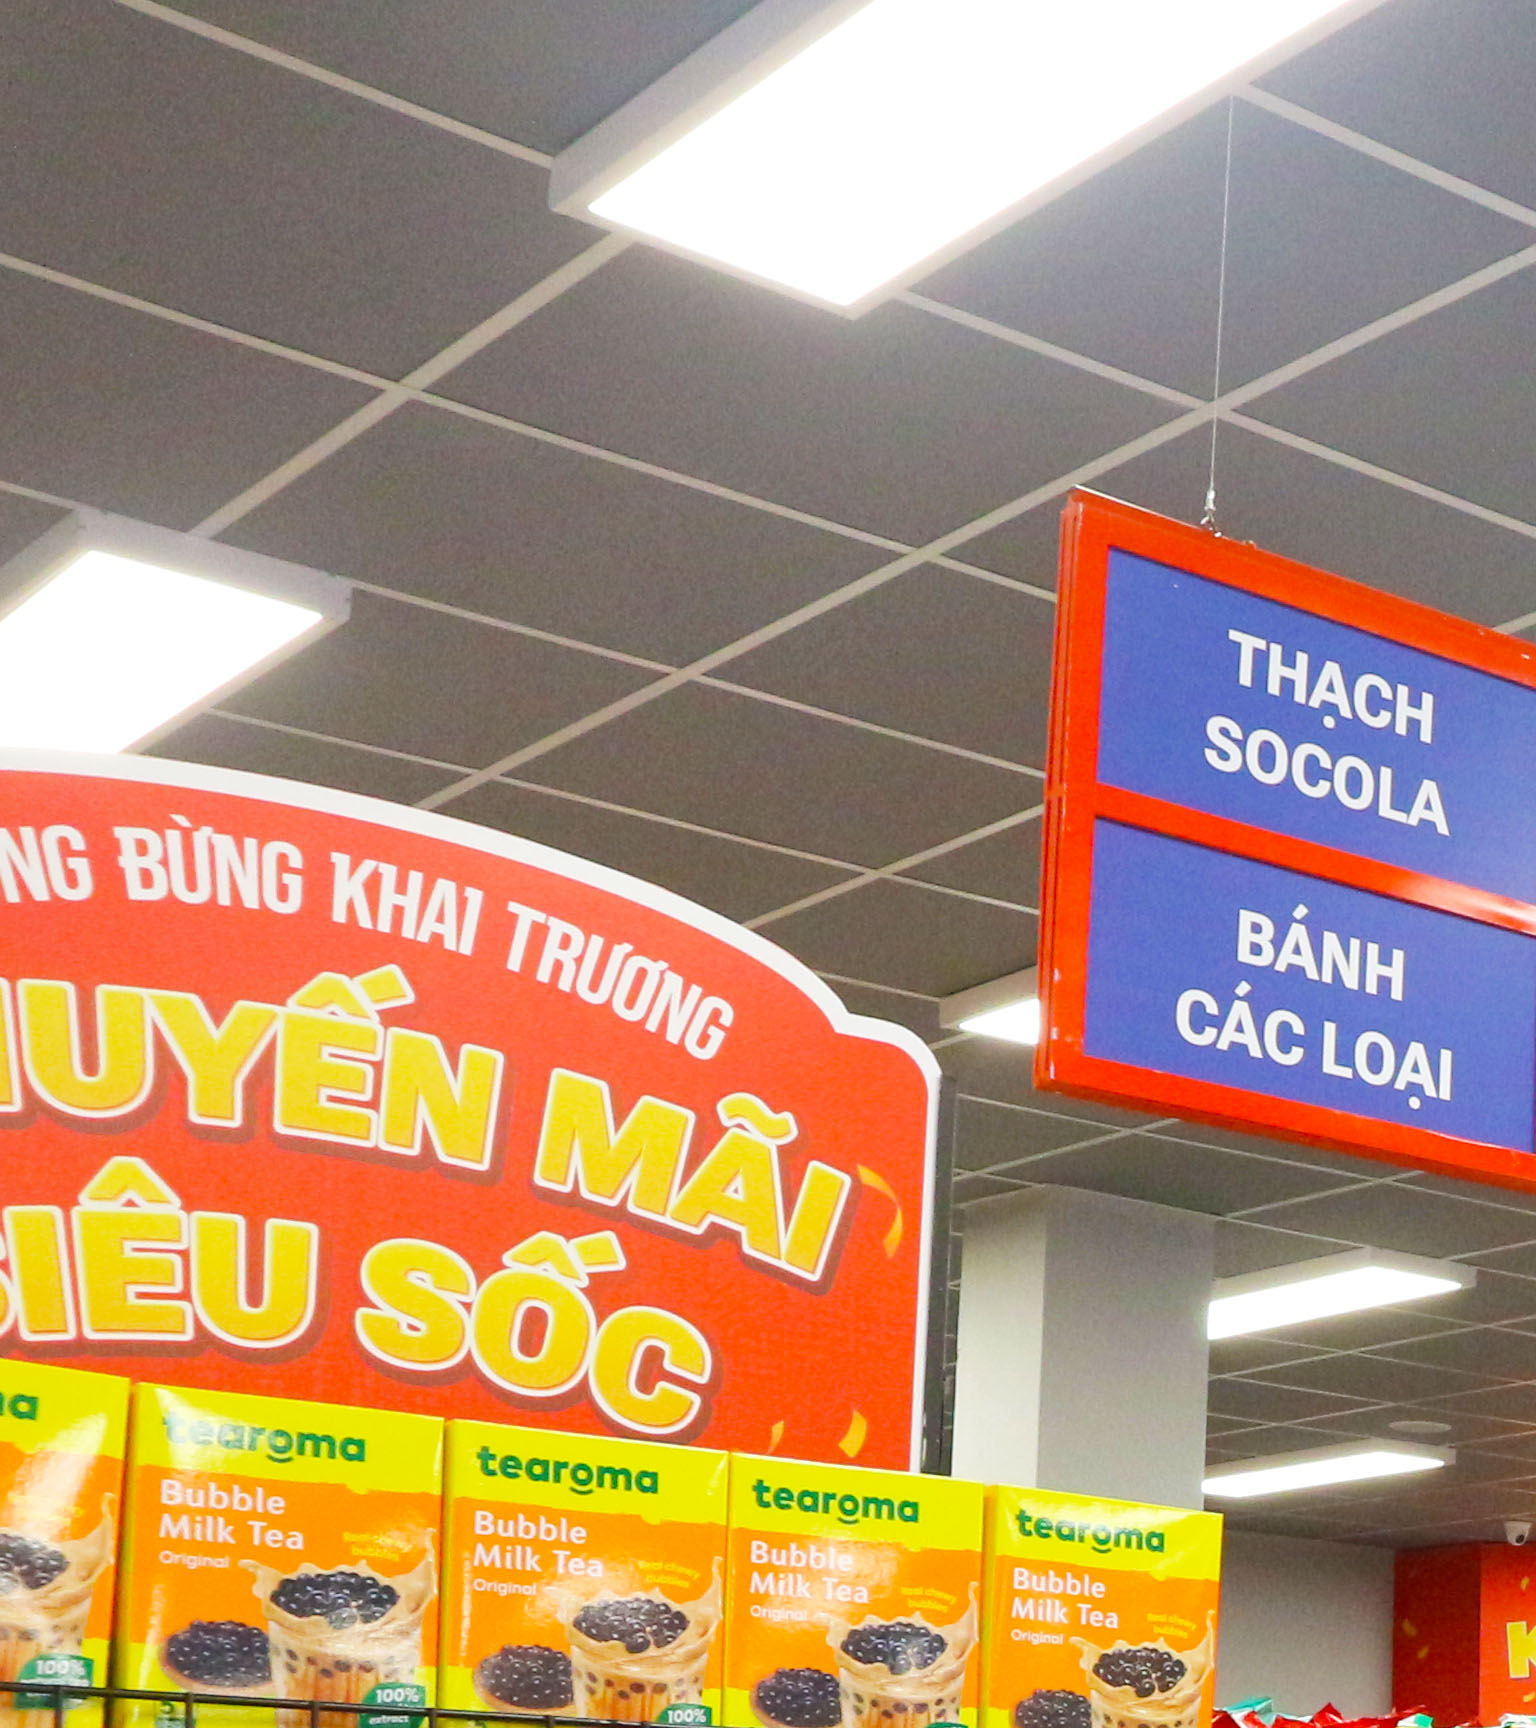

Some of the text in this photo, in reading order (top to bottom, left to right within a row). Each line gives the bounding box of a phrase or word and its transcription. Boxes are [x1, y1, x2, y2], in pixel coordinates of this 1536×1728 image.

[1227, 628, 1434, 744] THẠCH
[1203, 716, 1451, 837] SOCOLA
[0, 816, 734, 1061] NG BỪNG KHAI TRƯƠNG
[1236, 905, 1405, 1002] BÁNH
[1175, 983, 1453, 1111] CÁC LOẠI
[0, 964, 852, 1282] UYẾN MÃI
[355, 1231, 715, 1434] SỐC
[1012, 1567, 1107, 1600] Bubble
[1015, 1509, 1166, 1554] tearoma
[1010, 1628, 1064, 1646] Original
[1011, 1595, 1120, 1630] Milk Tea
